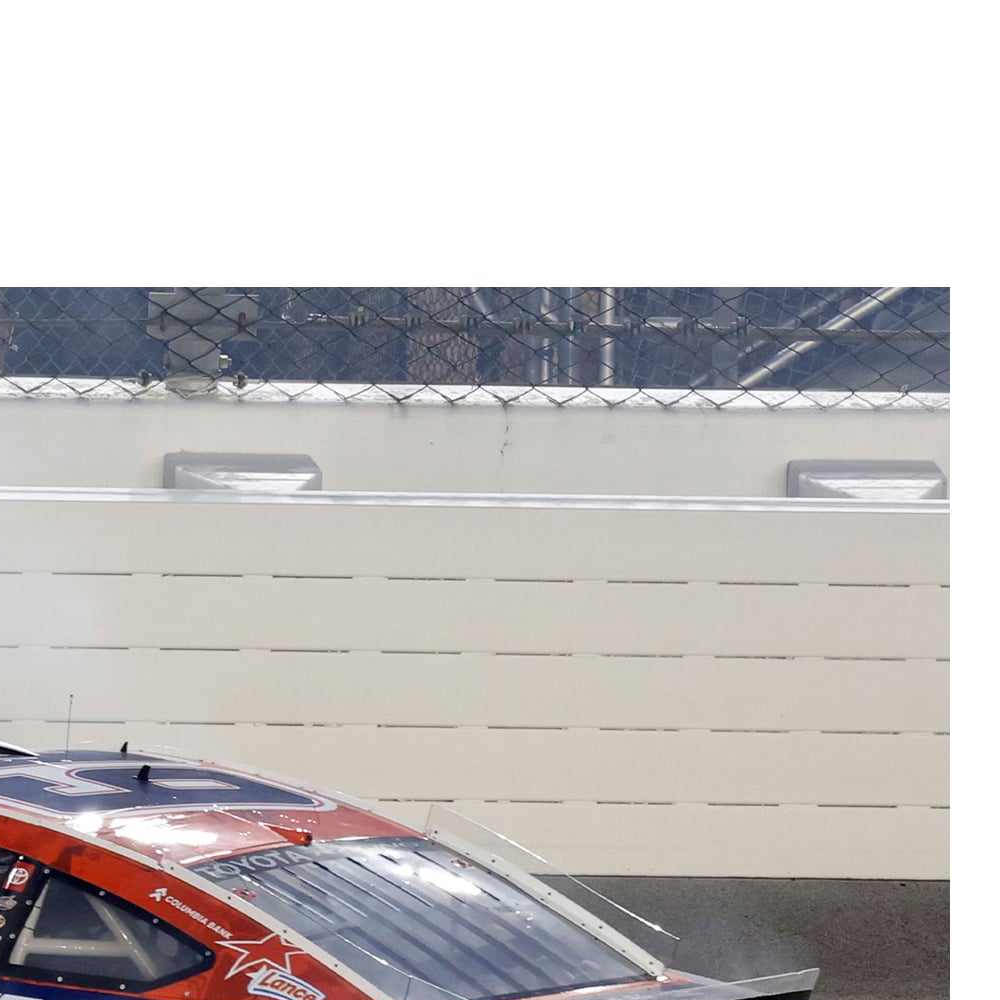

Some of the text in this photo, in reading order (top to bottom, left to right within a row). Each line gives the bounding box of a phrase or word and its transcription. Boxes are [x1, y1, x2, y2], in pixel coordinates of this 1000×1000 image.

[194, 850, 311, 878] TOYOTA
[165, 895, 235, 941] COLUMBIA BANK
